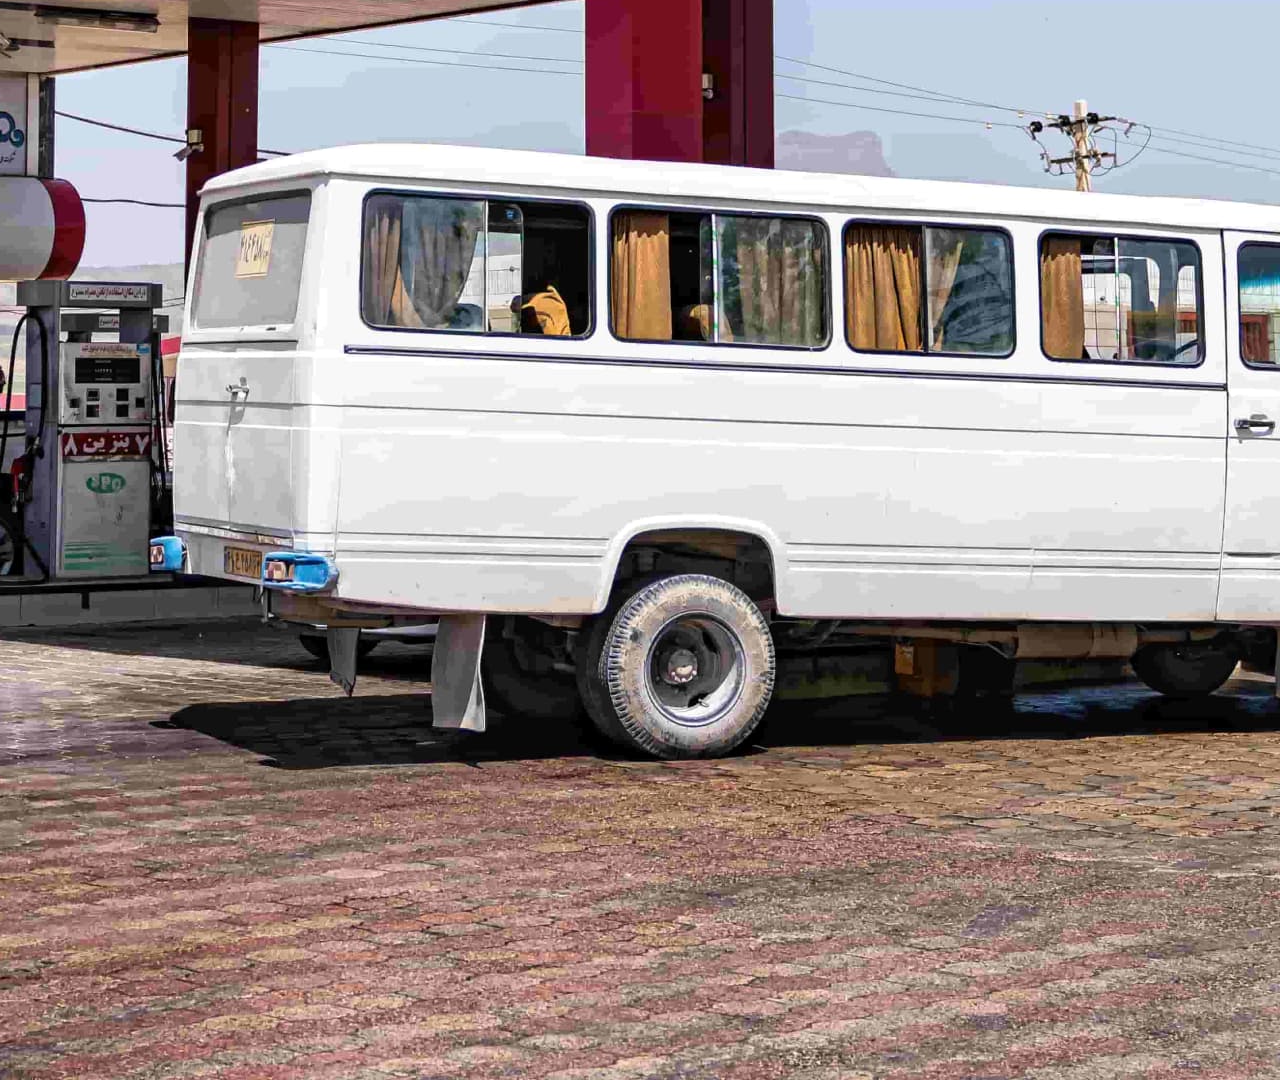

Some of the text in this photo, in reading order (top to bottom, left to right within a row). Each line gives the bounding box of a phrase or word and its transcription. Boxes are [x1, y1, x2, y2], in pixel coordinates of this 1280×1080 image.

[64, 433, 78, 456] ۸
[83, 433, 130, 454] بنزین
[135, 434, 149, 455] ۷
